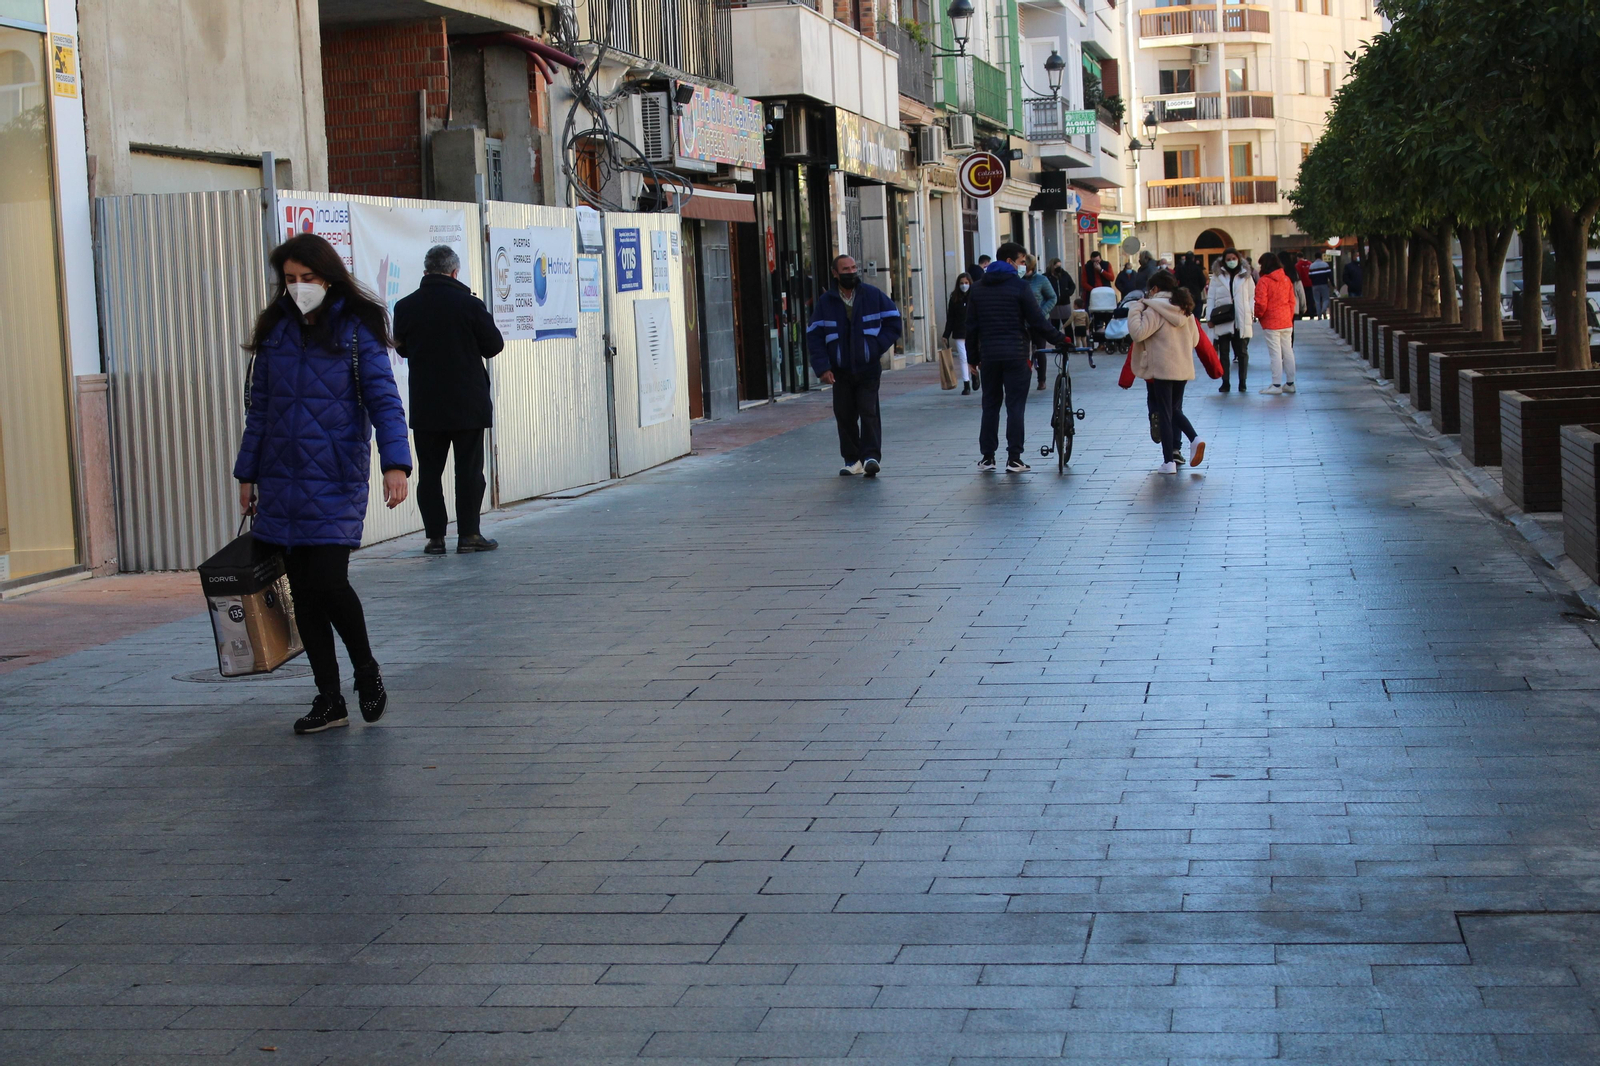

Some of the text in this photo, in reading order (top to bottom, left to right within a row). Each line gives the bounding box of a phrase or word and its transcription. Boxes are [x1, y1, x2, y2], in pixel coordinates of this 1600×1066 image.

[727, 99, 762, 134] Breakfast
[513, 238, 531, 248] PUERTAS
[513, 255, 531, 263] HERRAJES
[621, 247, 637, 270] OTIS
[547, 256, 573, 275] Hofrical
[515, 298, 533, 307] COCINAS
[209, 575, 238, 583] DORVEL
[230, 608, 243, 619] 135
